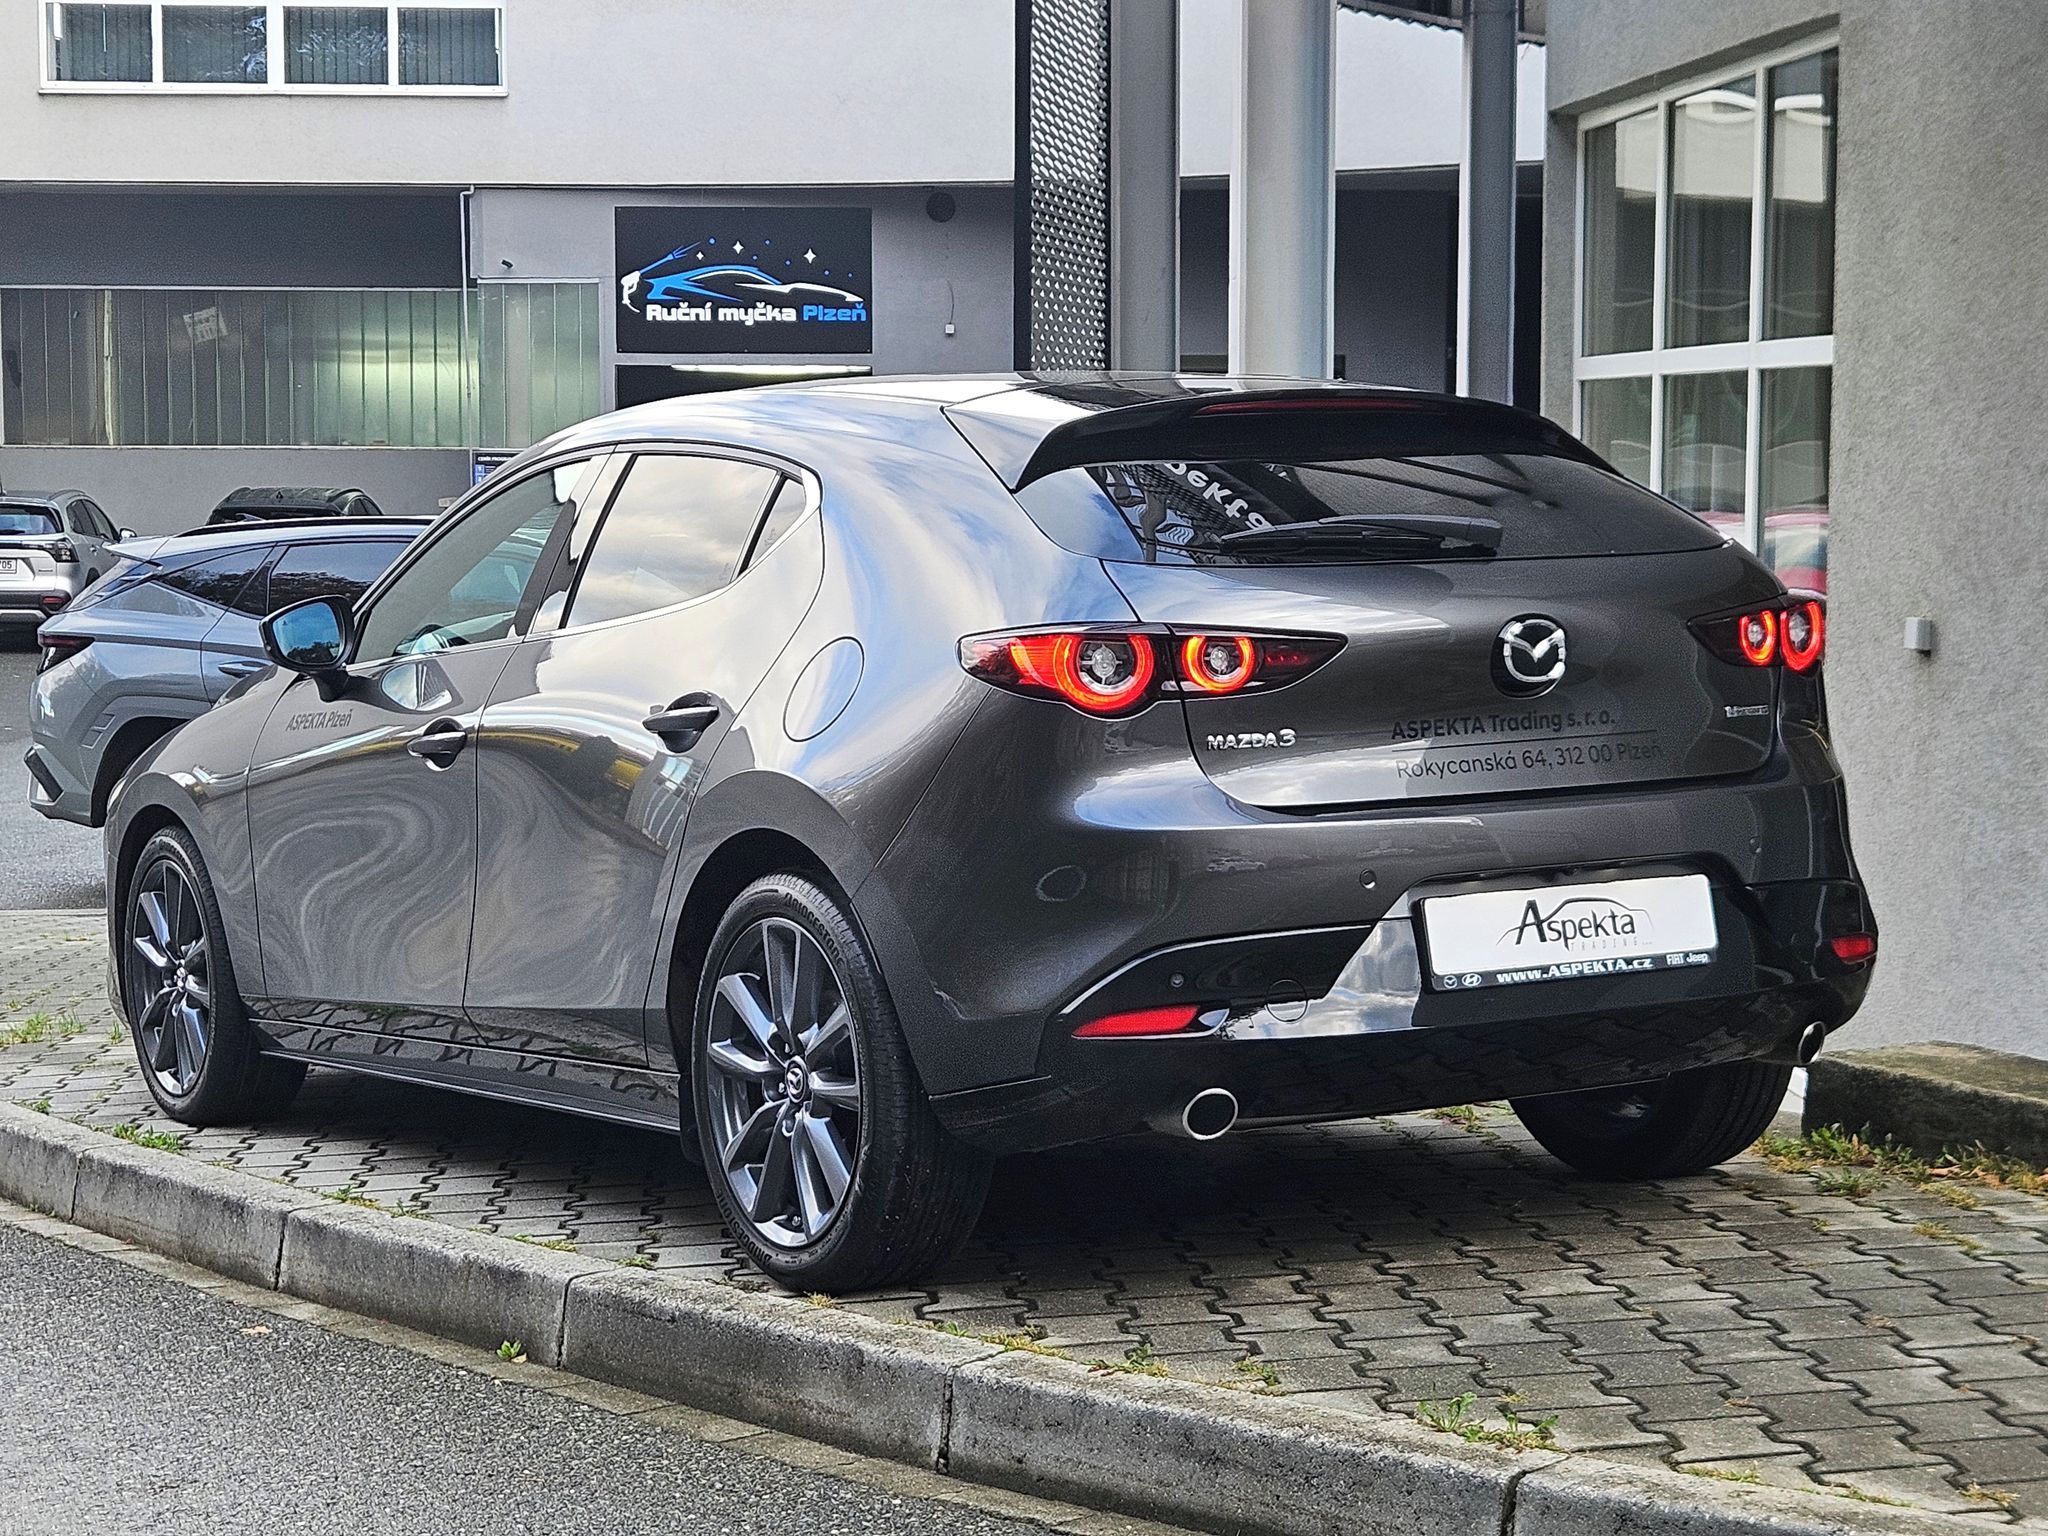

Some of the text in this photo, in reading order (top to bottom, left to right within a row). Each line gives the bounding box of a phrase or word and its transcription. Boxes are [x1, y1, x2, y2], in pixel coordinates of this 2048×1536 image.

[646, 302, 867, 326] Ruční myčka Plzeň
[0, 560, 12, 569] 05
[285, 708, 353, 732] ASPEKTA Plzeň
[1391, 716, 1486, 740] ASPEKTA
[1487, 712, 1562, 732] Trading
[1396, 750, 1517, 779] Rokycanská
[1588, 743, 1612, 763] 00
[1515, 899, 1636, 951] Aspekta
[1496, 952, 1709, 983] www.ASPEKTA.cz FIAT Jeep
